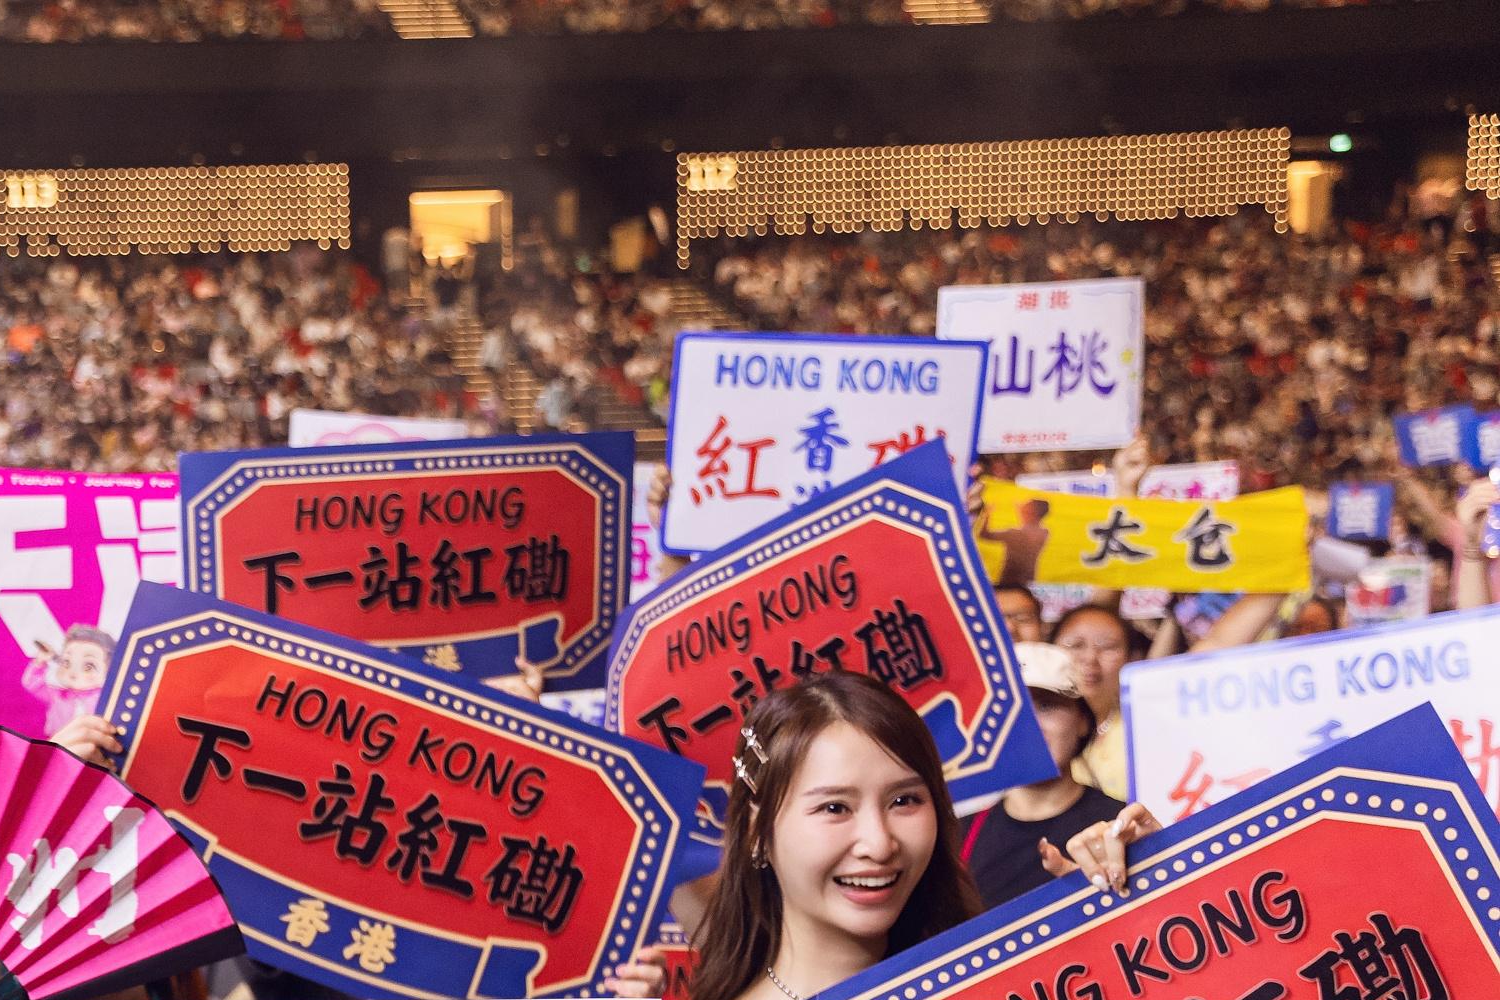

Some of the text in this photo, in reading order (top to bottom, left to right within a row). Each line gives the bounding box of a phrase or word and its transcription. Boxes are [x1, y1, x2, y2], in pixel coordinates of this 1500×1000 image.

[716, 354, 939, 393] HONG KONG
[690, 416, 780, 504] 紅
[295, 486, 525, 536] HONG KONG
[1083, 507, 1234, 567] 太仓
[242, 535, 570, 612] 下一站紅磡
[666, 554, 858, 672] HONG KONG
[1177, 640, 1473, 718] HONG KONG
[256, 675, 548, 816] HONG KONG
[176, 714, 585, 935] 下一站紅磡
[279, 899, 399, 976] 香港
[1115, 870, 1307, 997] KONG
